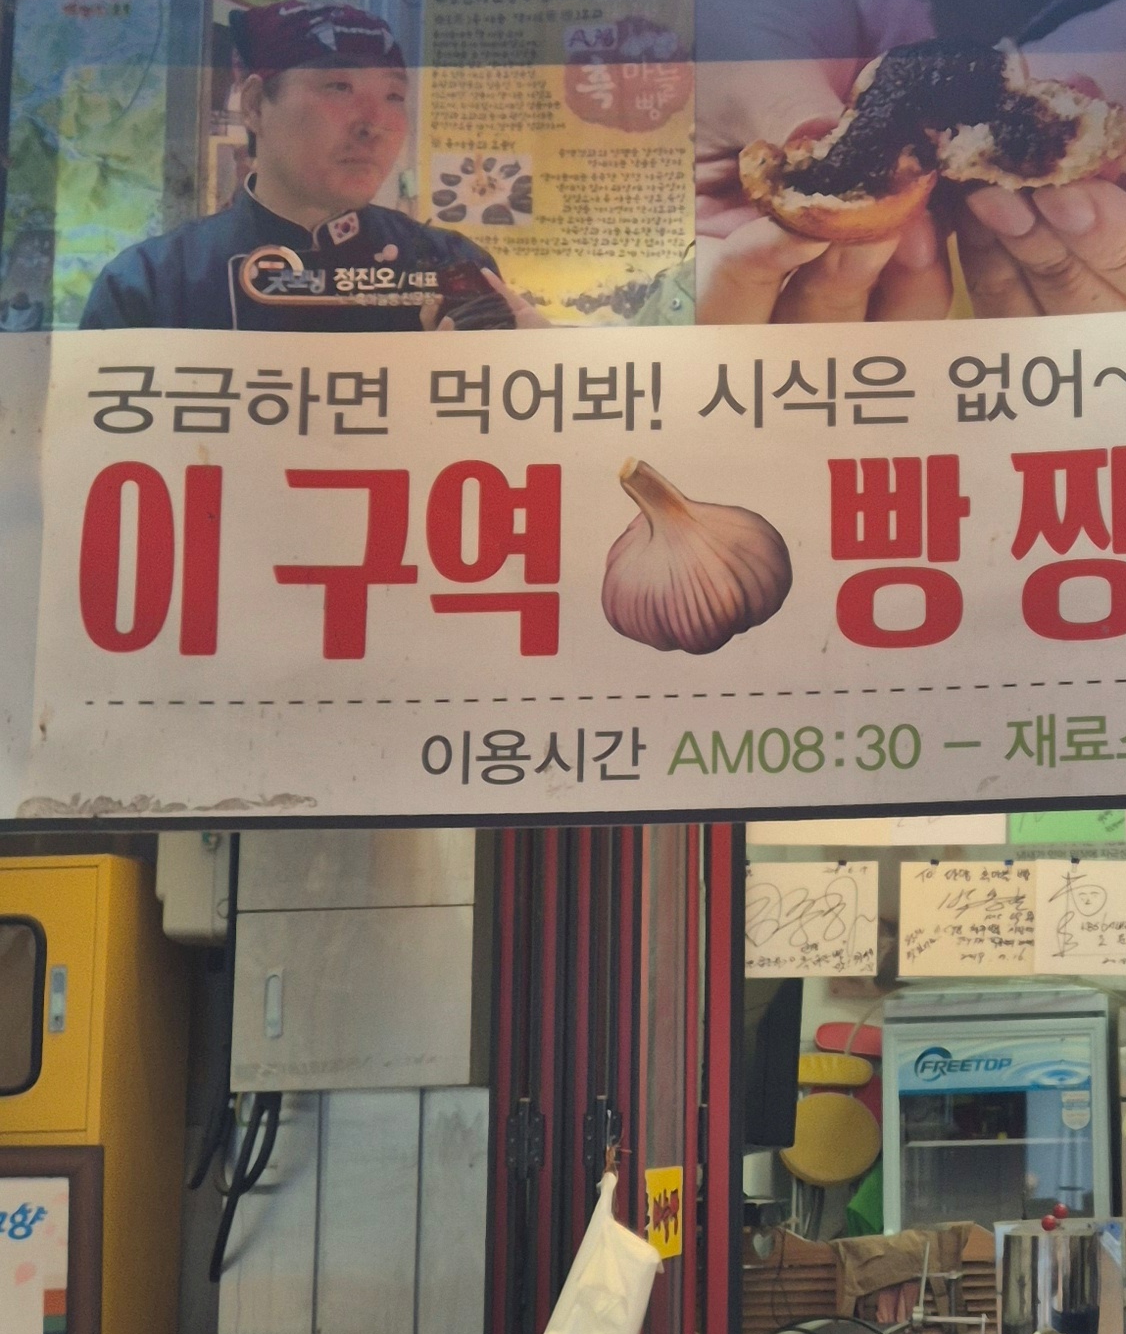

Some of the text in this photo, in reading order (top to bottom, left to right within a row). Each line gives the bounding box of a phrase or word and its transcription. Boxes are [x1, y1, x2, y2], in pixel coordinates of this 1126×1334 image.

[87, 365, 390, 437] 궁금하면
[429, 360, 664, 433] 먹어봐!
[698, 356, 915, 432] 시식은
[79, 459, 224, 658] 이
[274, 459, 562, 661] 구역
[828, 453, 971, 649] 빵
[421, 728, 647, 785] 이용시간
[667, 723, 921, 778] AM08:30
[918, 1057, 1012, 1077] FREETOP
